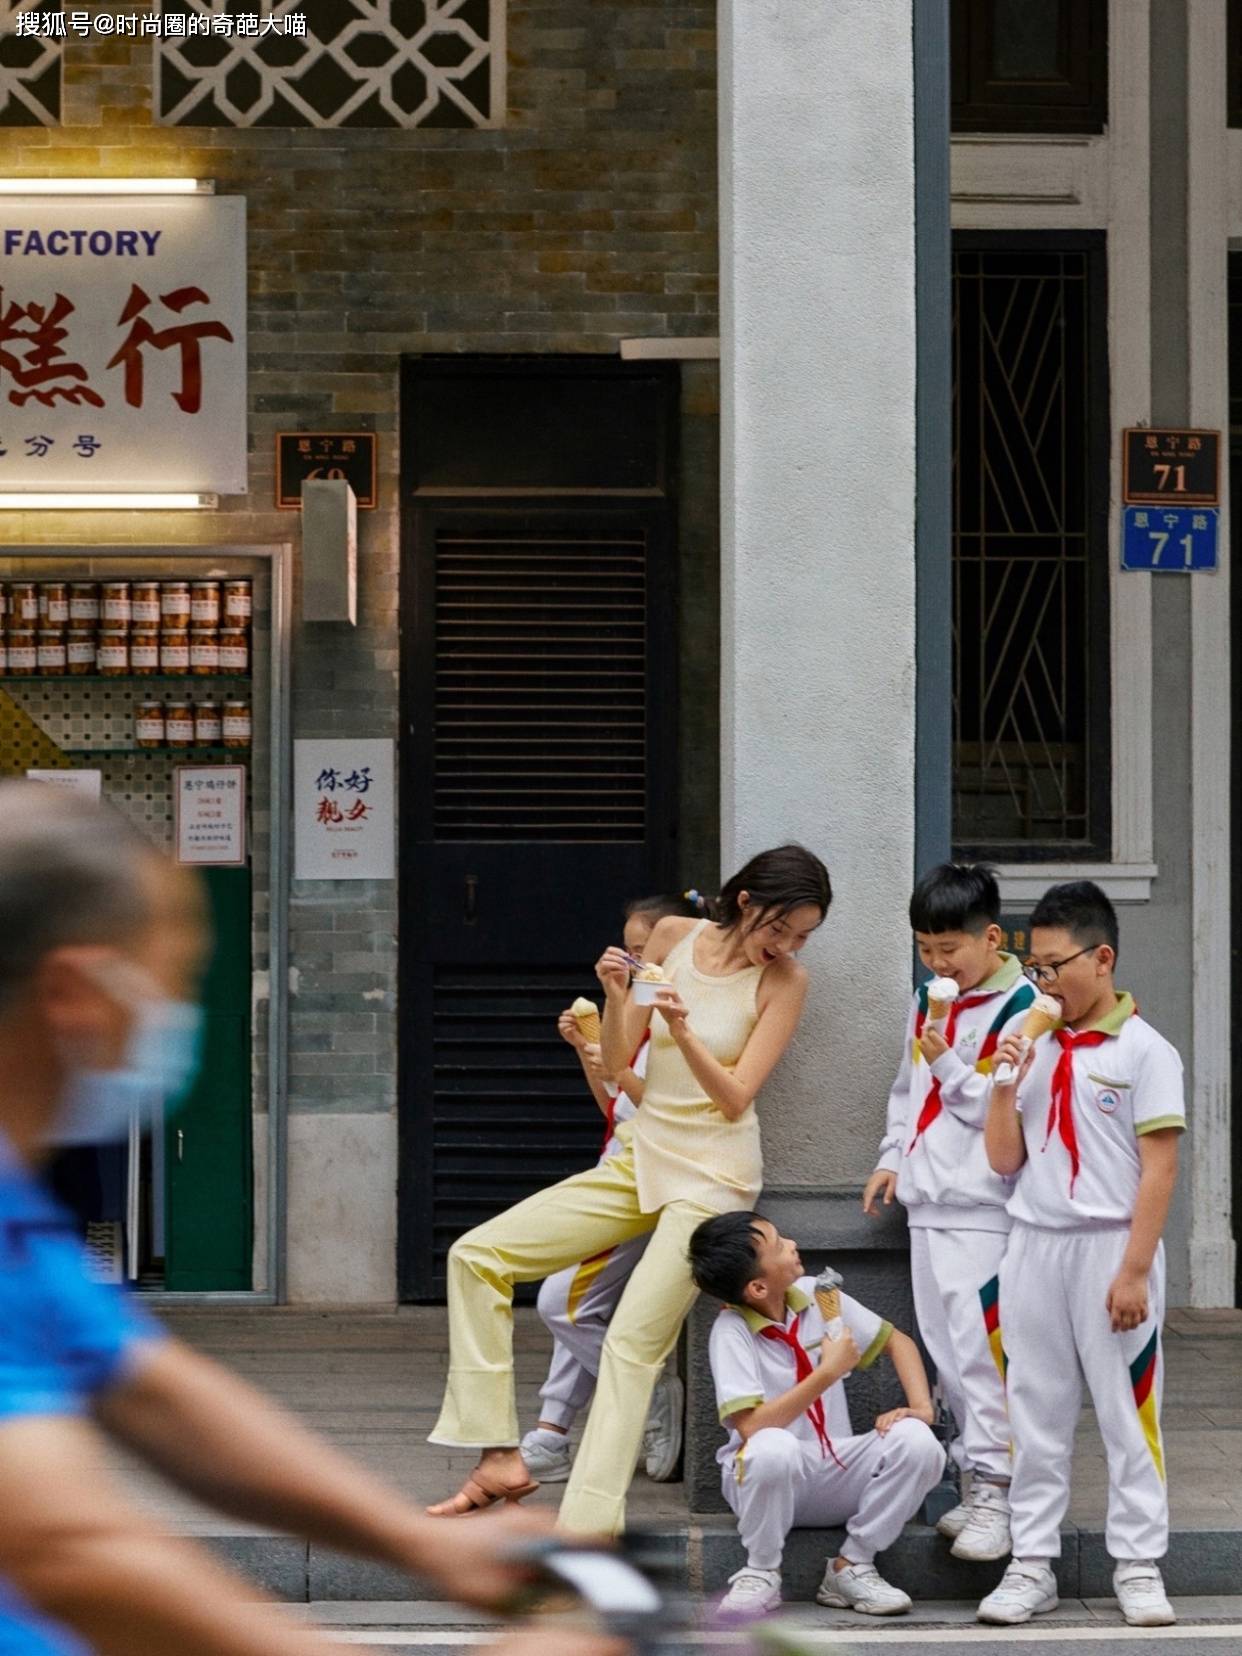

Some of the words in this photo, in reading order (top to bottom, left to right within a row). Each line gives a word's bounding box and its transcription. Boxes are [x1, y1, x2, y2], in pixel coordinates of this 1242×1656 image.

[4, 229, 162, 256] FACTORY
[0, 434, 102, 458] 分号
[1152, 464, 1187, 492] 71
[1134, 511, 1208, 530] 恩宁路
[1149, 531, 1193, 566] 71
[314, 767, 374, 793] 你好
